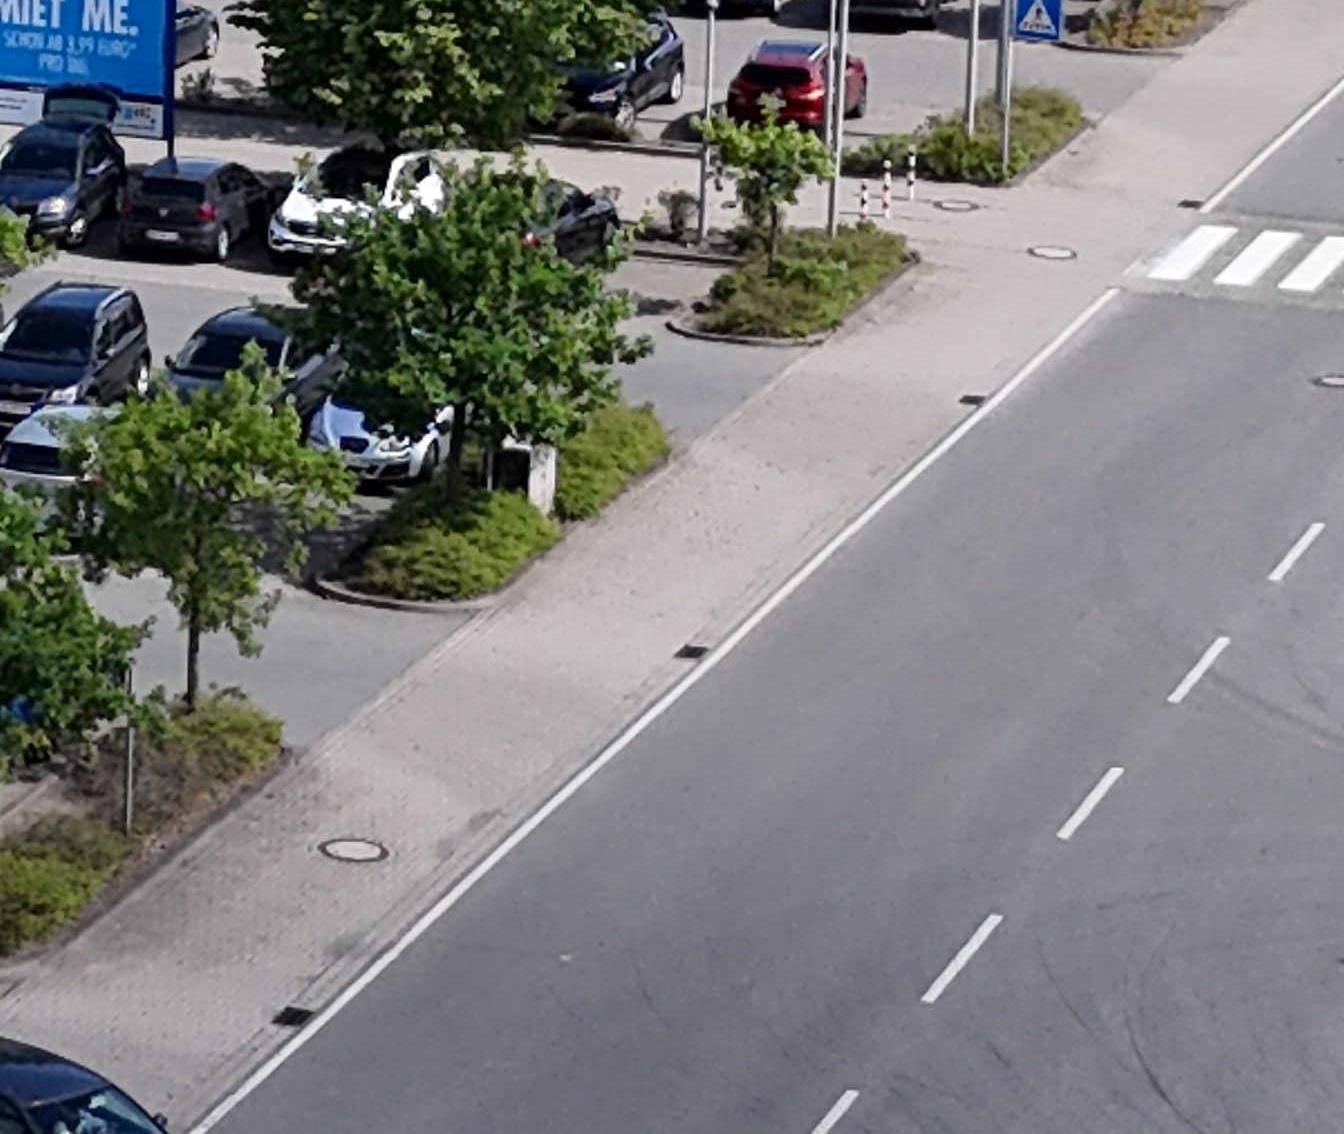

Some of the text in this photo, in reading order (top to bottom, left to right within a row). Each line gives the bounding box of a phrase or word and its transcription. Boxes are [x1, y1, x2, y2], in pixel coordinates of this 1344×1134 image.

[3, 30, 45, 50] SCHON
[46, 34, 63, 51] AB
[66, 35, 94, 56] 3,99
[38, 53, 62, 72] PRO
